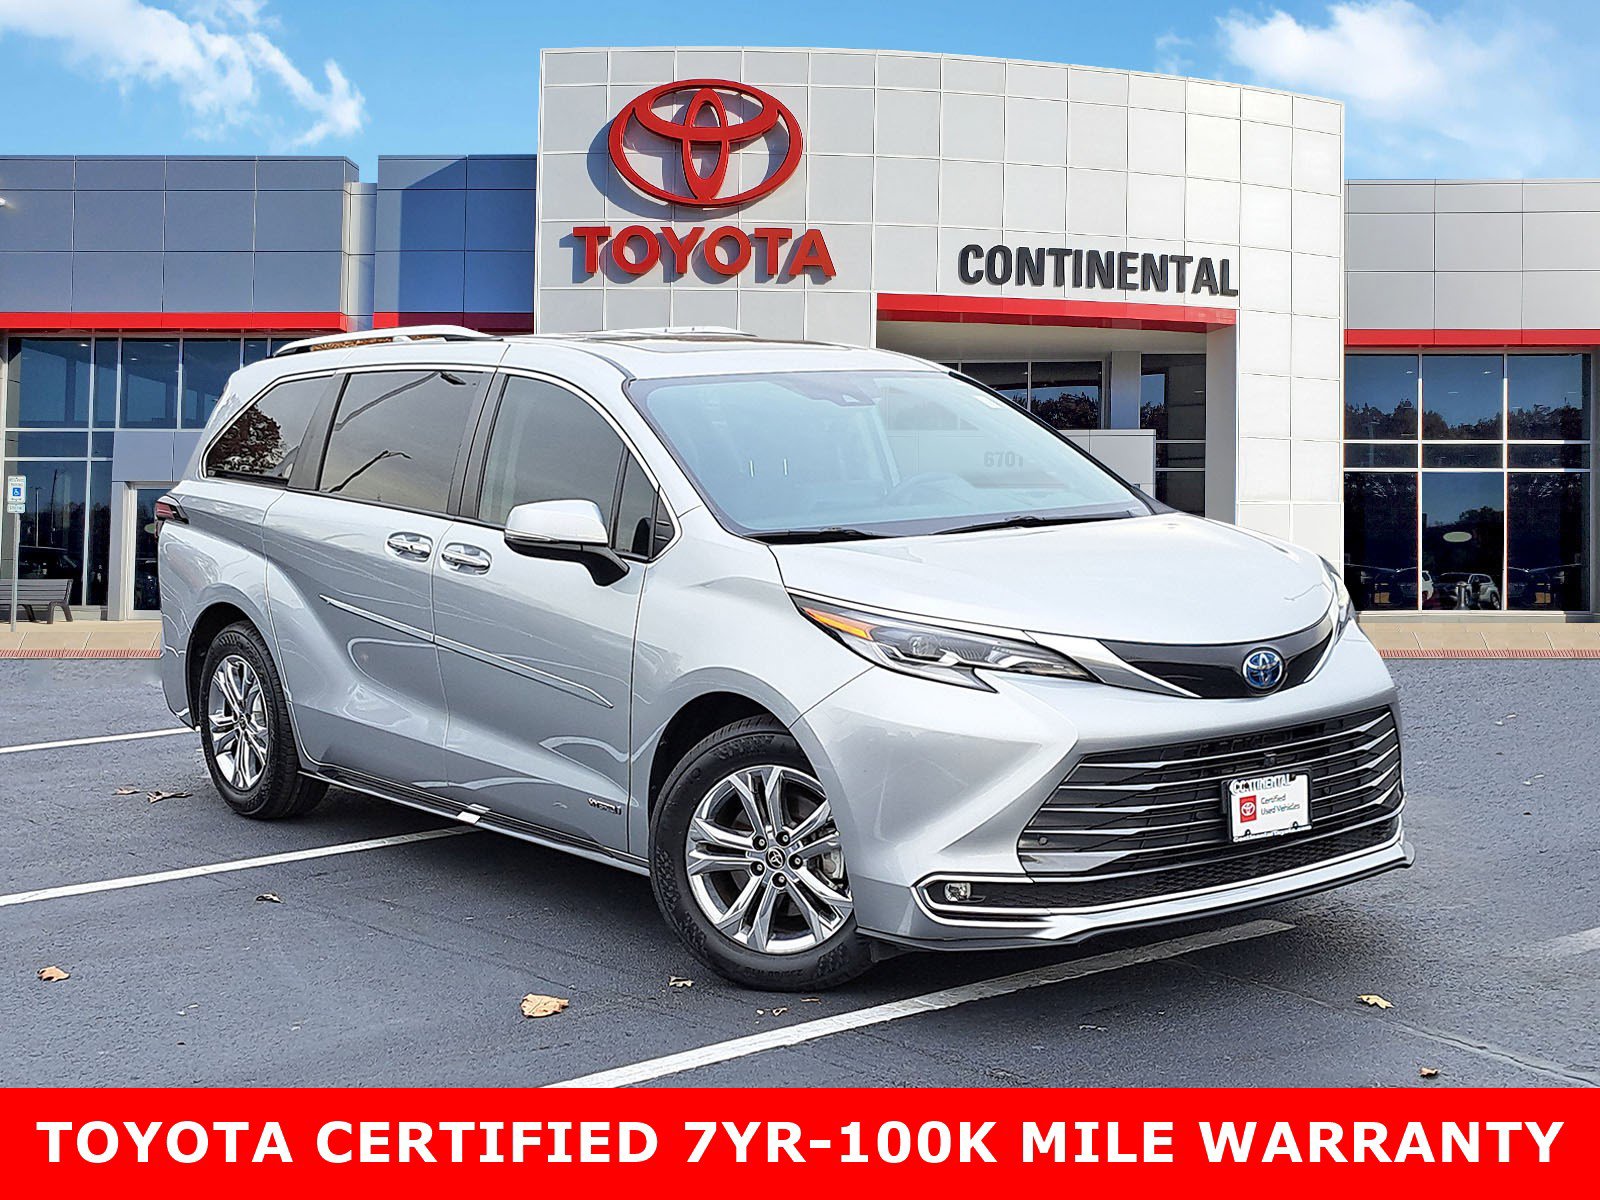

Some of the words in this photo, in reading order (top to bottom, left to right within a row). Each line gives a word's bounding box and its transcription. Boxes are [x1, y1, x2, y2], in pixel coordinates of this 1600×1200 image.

[572, 225, 837, 278] TOYOTA
[958, 244, 1239, 297] CONTINENTAL
[983, 451, 1024, 468] 6701
[1260, 793, 1287, 805] Certified
[1260, 805, 1277, 816] Used
[1277, 802, 1301, 813] Vehicles
